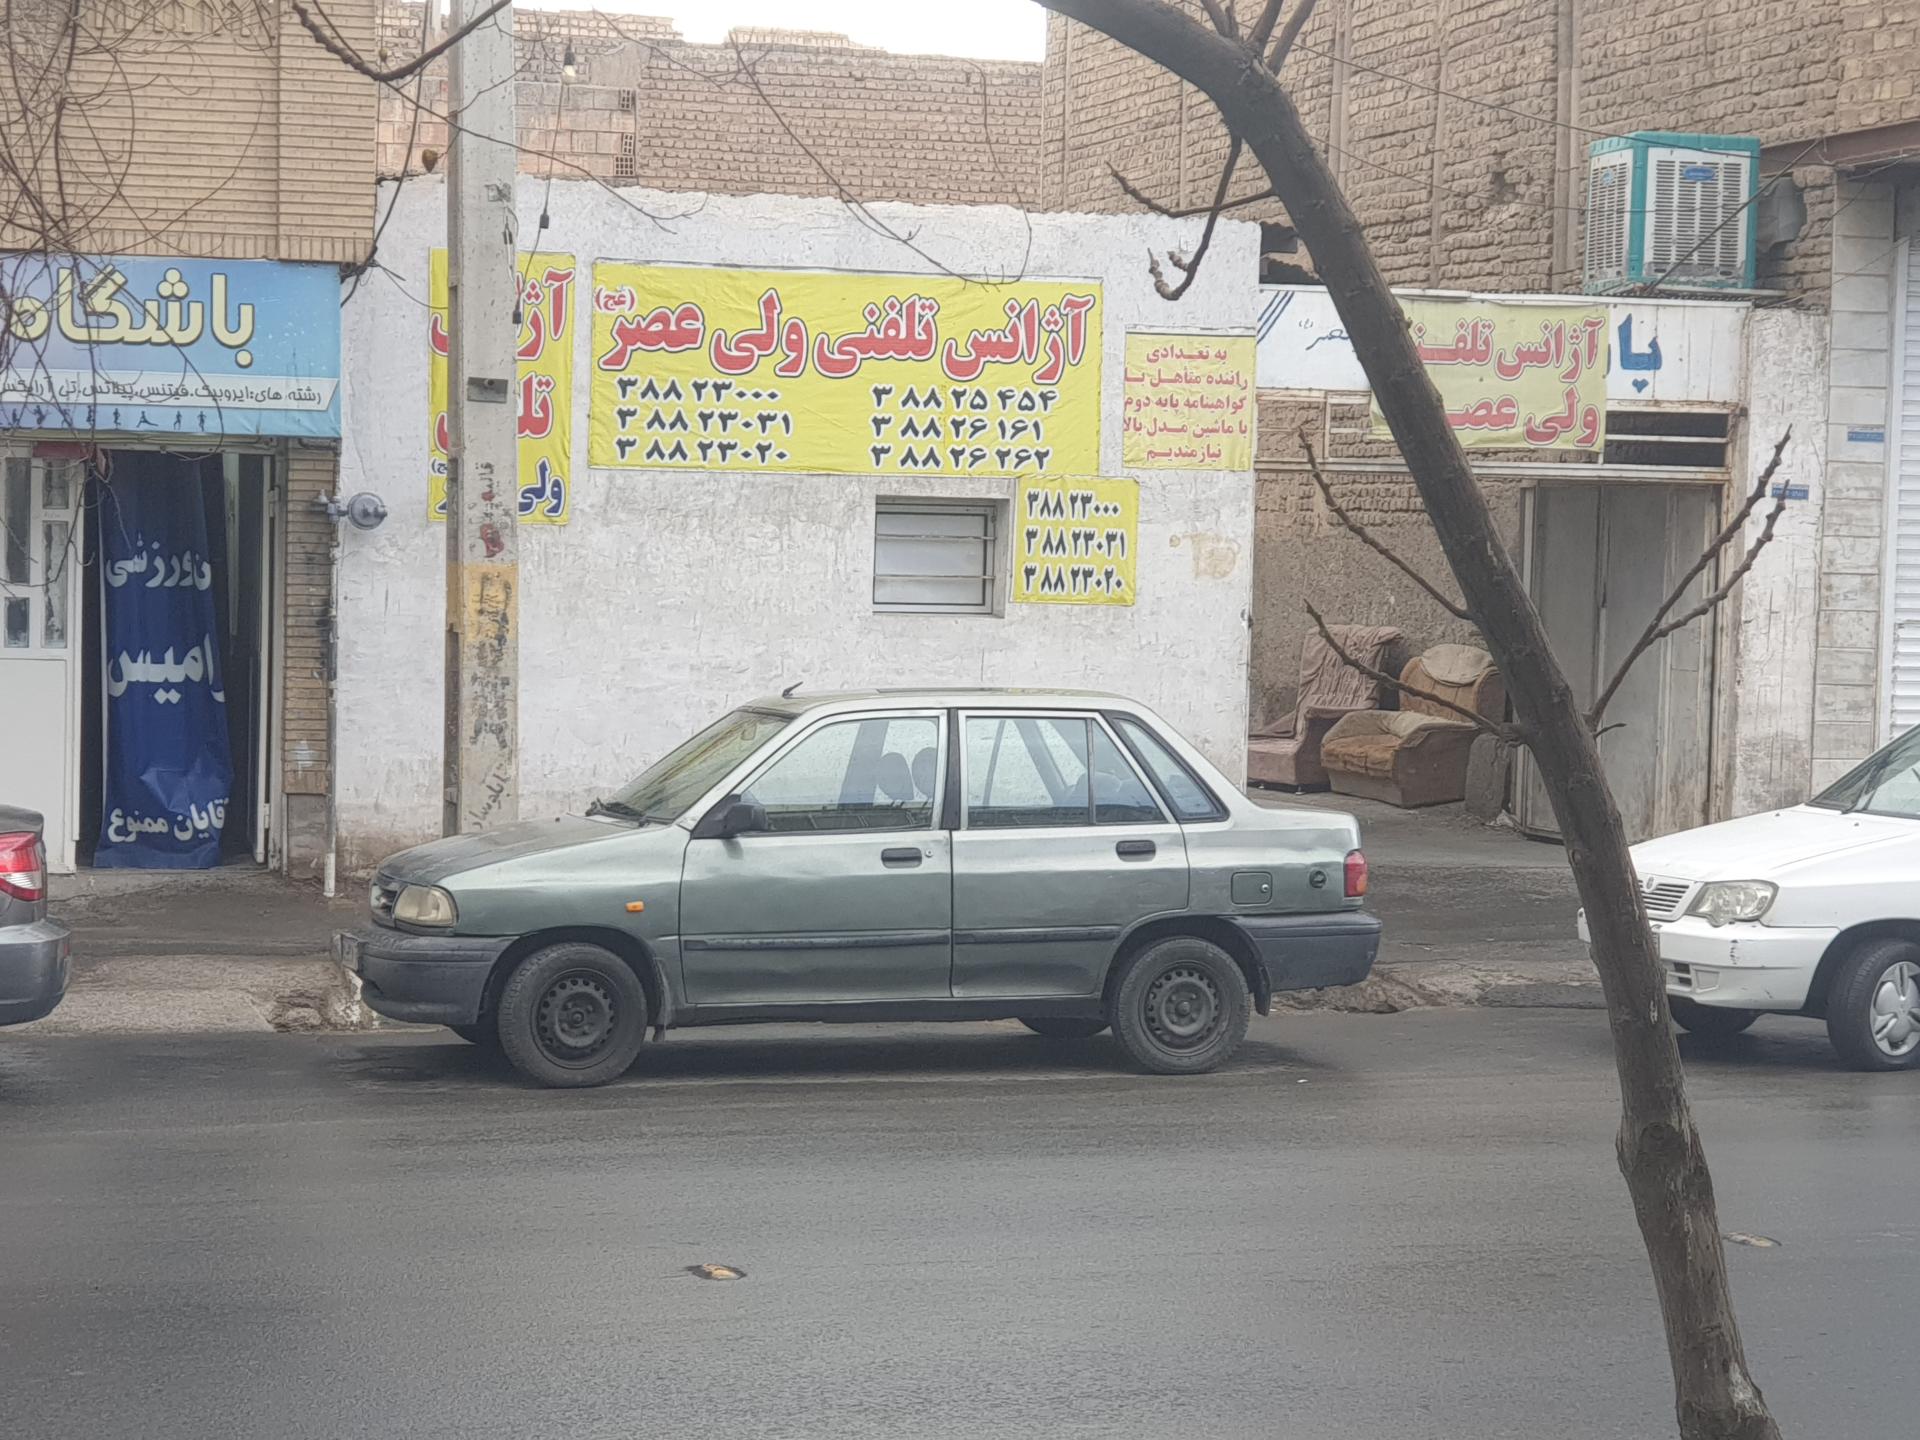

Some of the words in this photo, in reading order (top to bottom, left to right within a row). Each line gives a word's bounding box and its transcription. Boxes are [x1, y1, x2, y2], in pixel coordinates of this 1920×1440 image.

[9, 264, 255, 368] باشگاه
[599, 303, 704, 370] عصر
[711, 288, 807, 377] ولی
[814, 294, 938, 377] تلفنی
[944, 294, 1095, 382] آژانس
[1414, 316, 1494, 365] تلفن
[1147, 344, 1209, 363] تعدادی
[1214, 349, 1227, 364] به
[1497, 316, 1604, 382] آژانس
[1124, 367, 1145, 386] با
[1206, 370, 1248, 390] راننده
[1124, 396, 1151, 413] دوم
[1155, 393, 1179, 414] پایه
[1446, 396, 1519, 430] عص
[1525, 384, 1599, 447] ولی
[1123, 416, 1143, 436] بالا
[1146, 417, 1188, 436] مدل
[1192, 419, 1233, 438] ماشین
[1238, 419, 1248, 438] با
[108, 808, 169, 842] ممنوع
